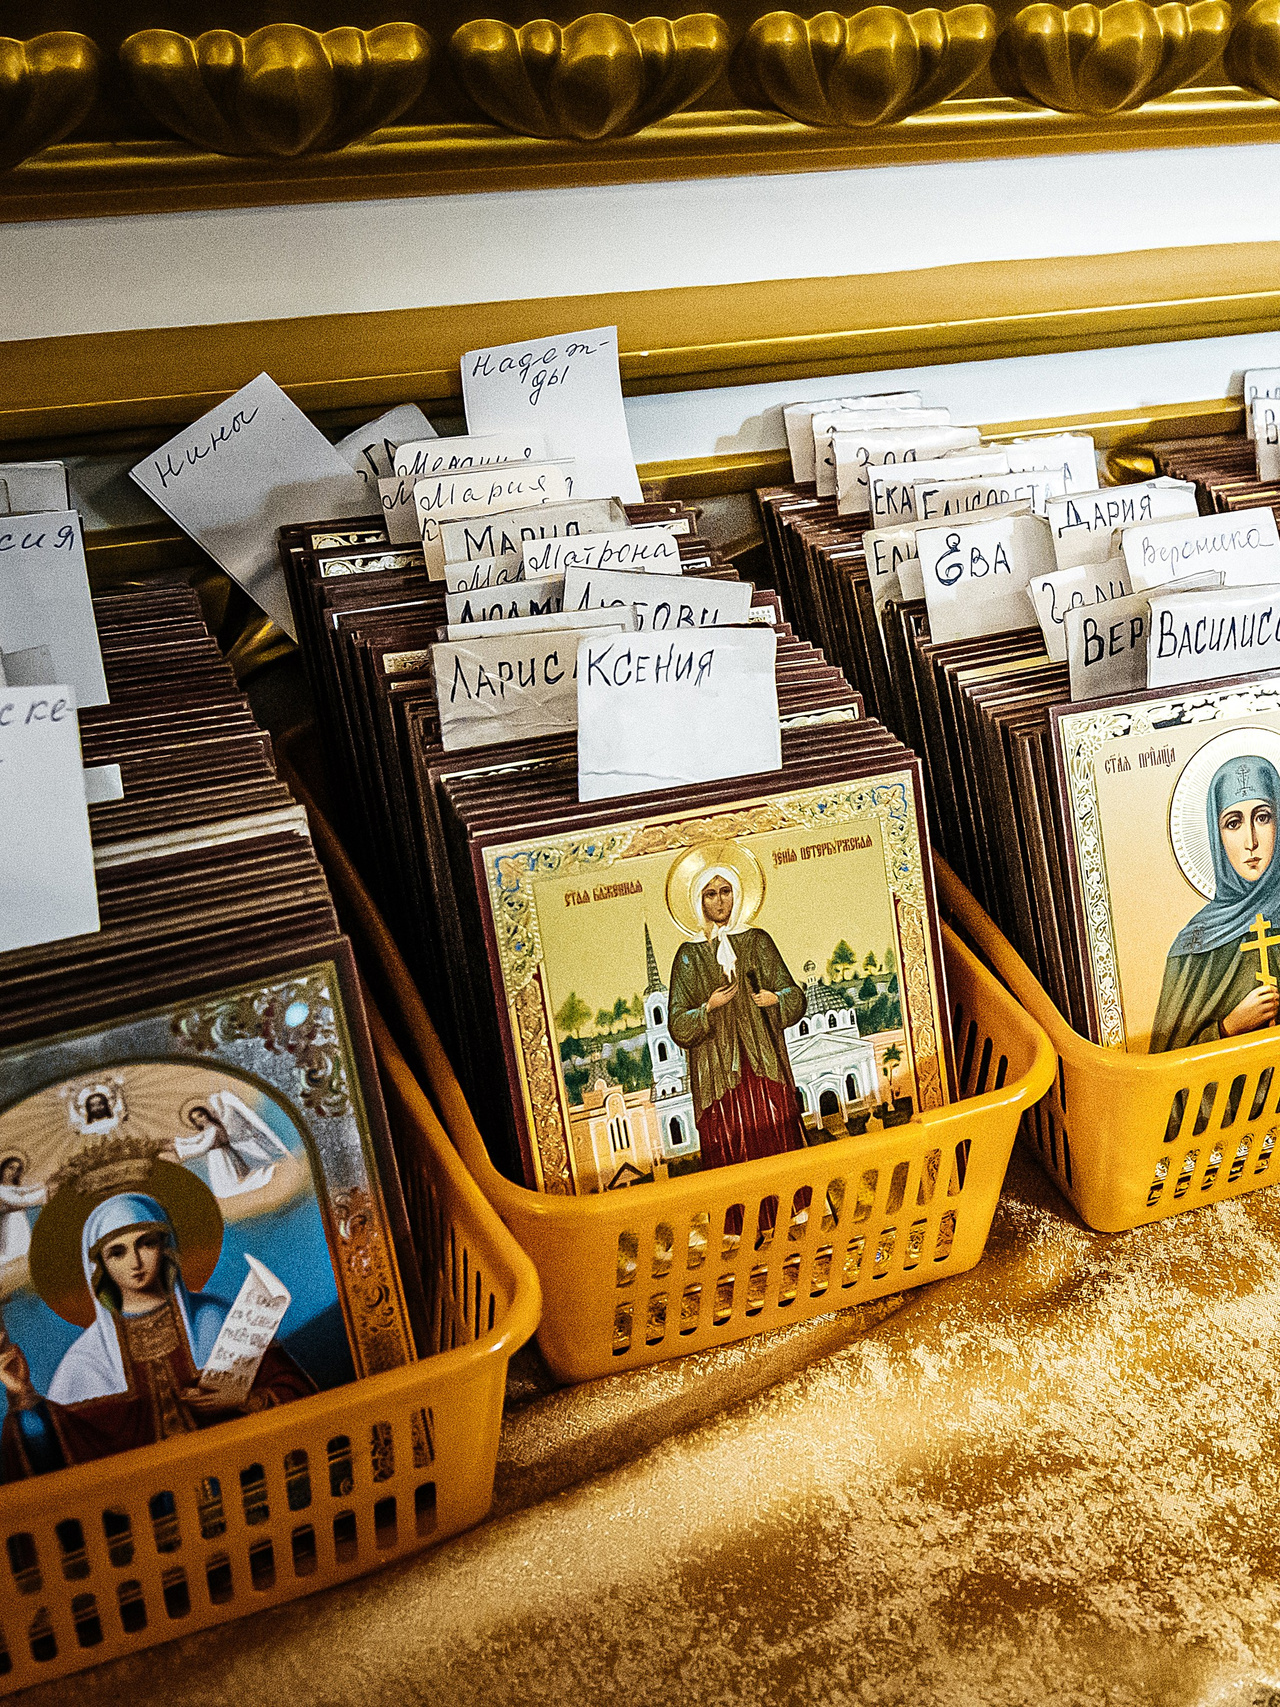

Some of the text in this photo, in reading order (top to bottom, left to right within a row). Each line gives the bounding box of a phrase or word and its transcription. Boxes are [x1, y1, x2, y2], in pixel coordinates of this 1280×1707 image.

[872, 477, 914, 515] ЕКА
[1058, 493, 1153, 539] ДАРИЯ
[528, 539, 678, 571] Матрона
[935, 532, 1012, 587] ЕВА
[1141, 526, 1275, 576] Вероника
[587, 642, 715, 689] КСЕНИЯ
